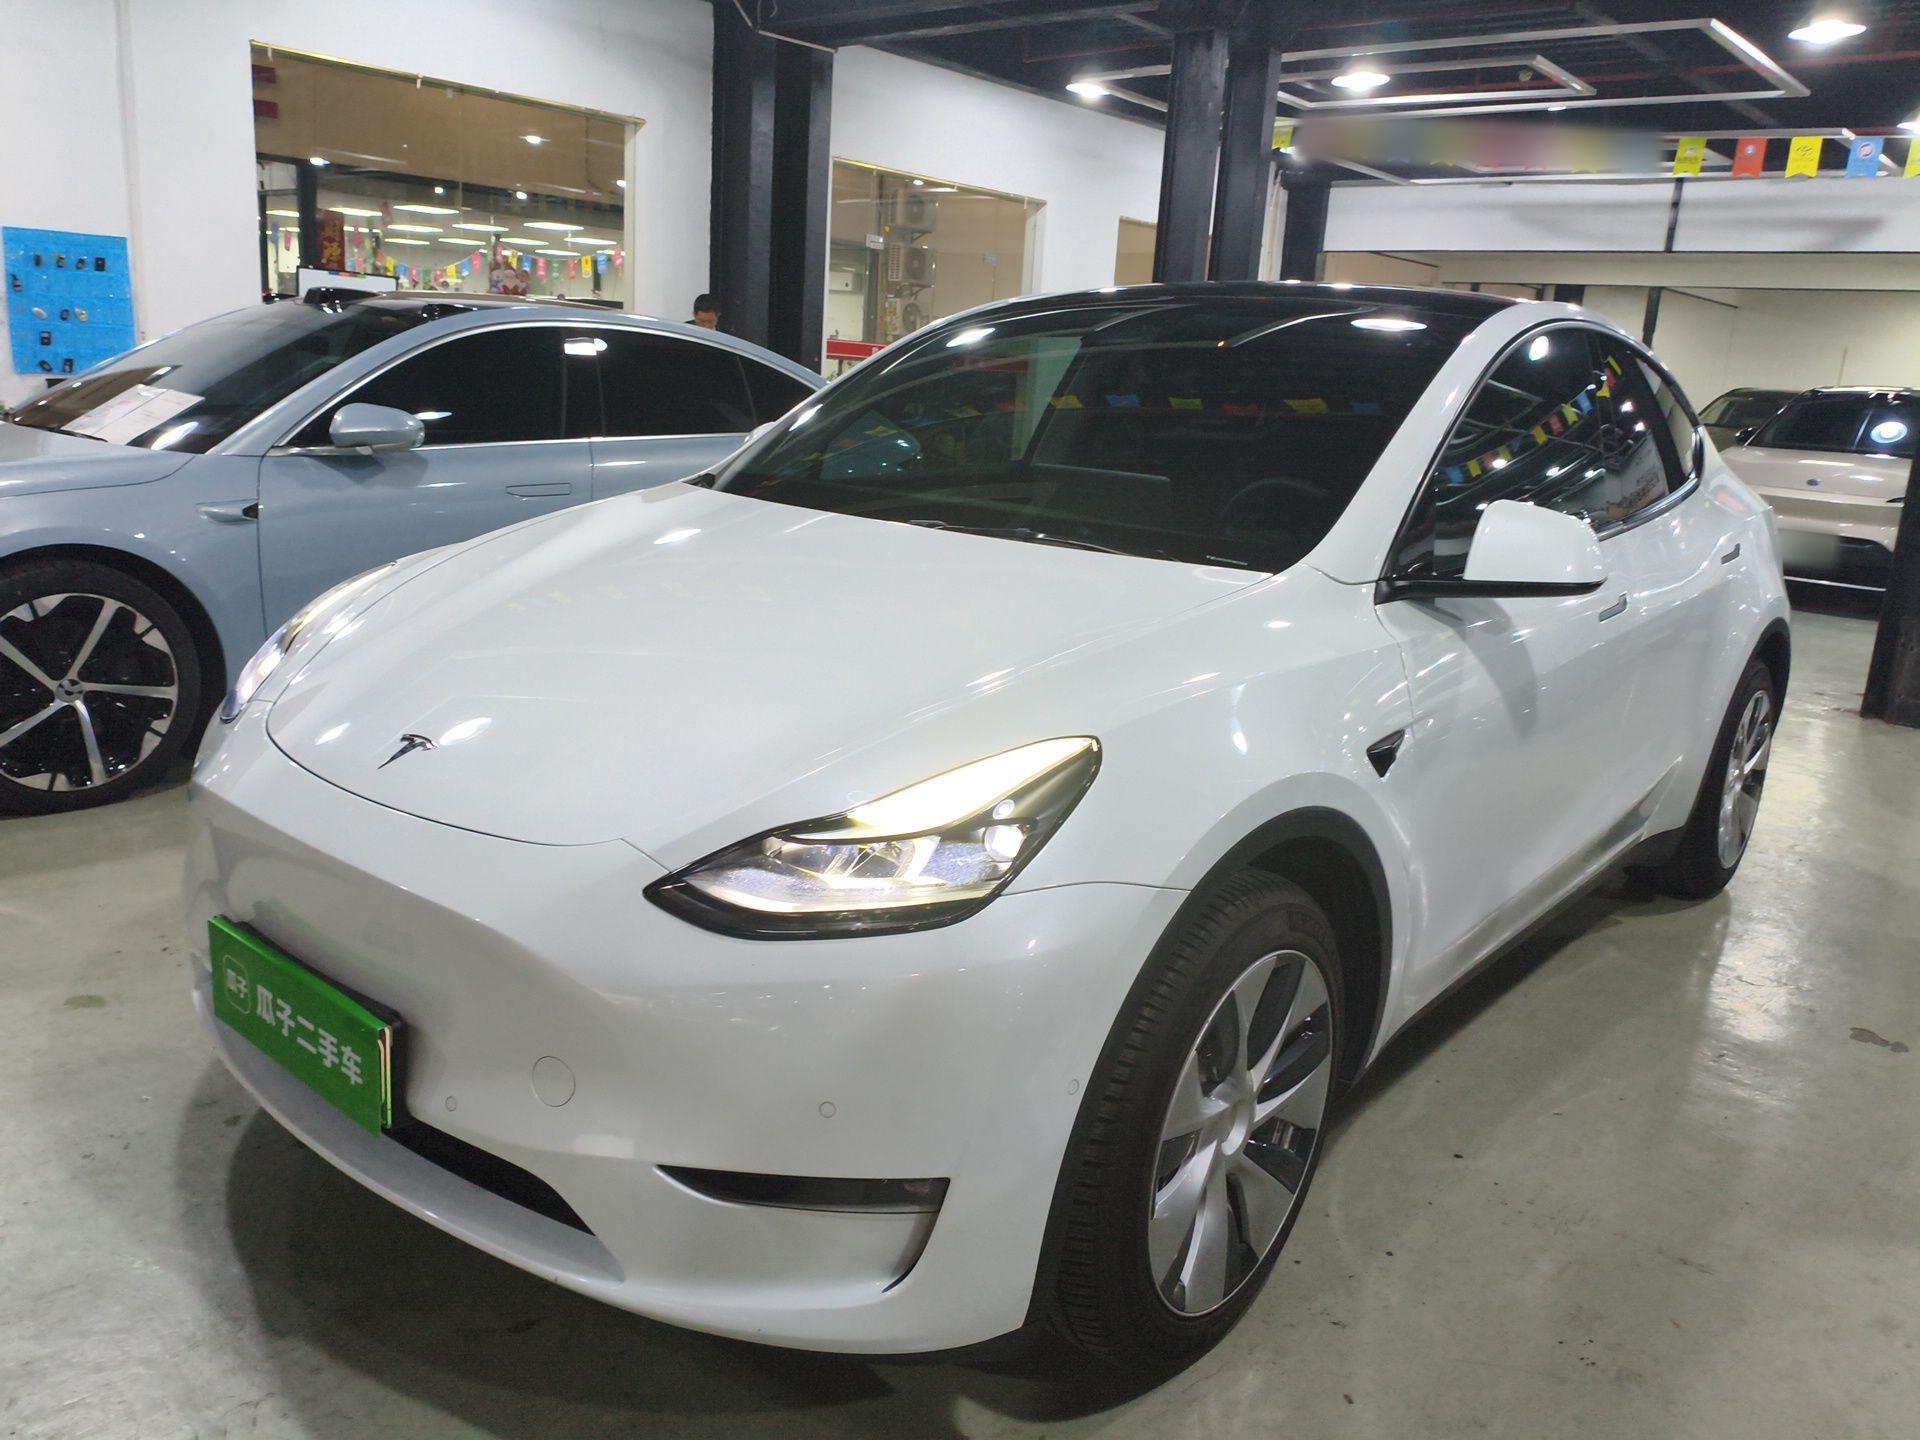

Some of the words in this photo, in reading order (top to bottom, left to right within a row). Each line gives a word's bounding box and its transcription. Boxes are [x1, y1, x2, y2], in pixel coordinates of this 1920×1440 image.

[257, 984, 363, 1085] 瓜子二手车
